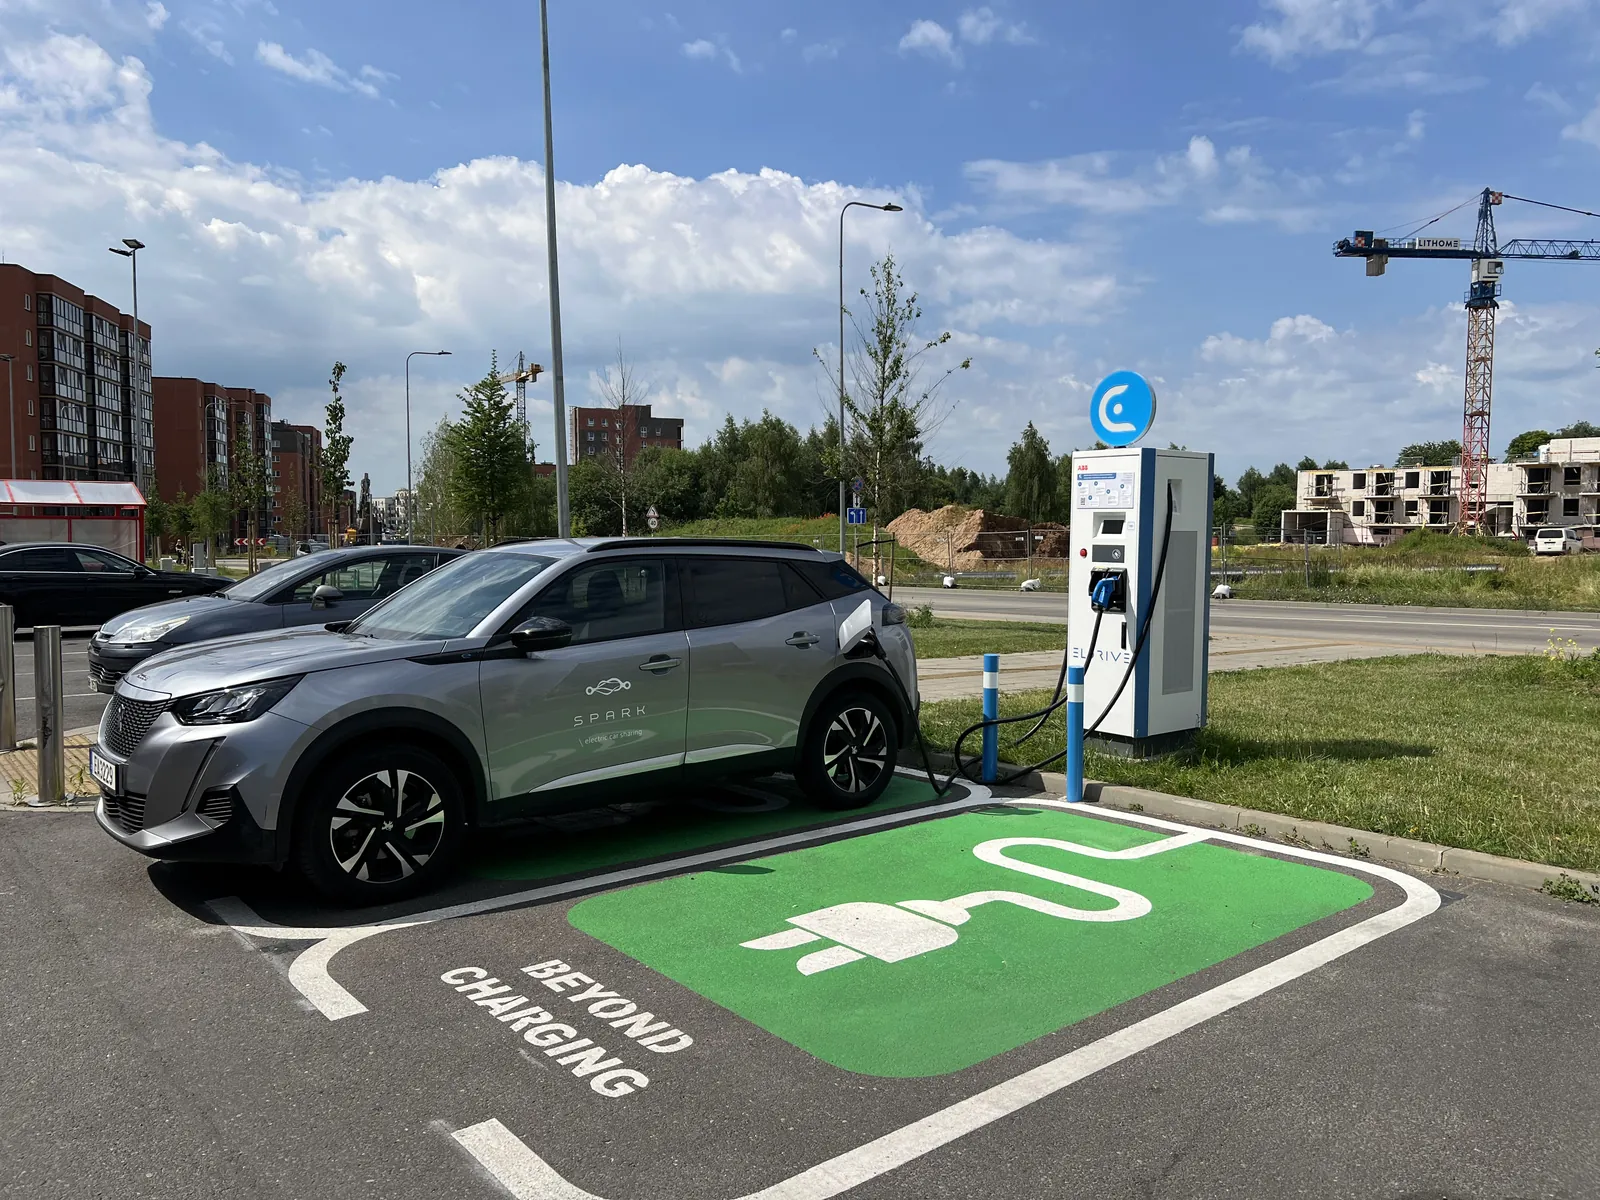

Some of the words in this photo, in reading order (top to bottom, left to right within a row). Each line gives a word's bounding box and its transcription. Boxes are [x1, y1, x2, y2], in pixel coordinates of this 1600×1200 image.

[1419, 239, 1459, 248] LITHOME
[1073, 647, 1130, 664] ELRIVE
[573, 705, 646, 728] SPARK
[584, 735, 608, 744] electric
[619, 729, 643, 738] sharing
[520, 959, 694, 1053] BEYOND
[440, 966, 649, 1098] CHARGING
